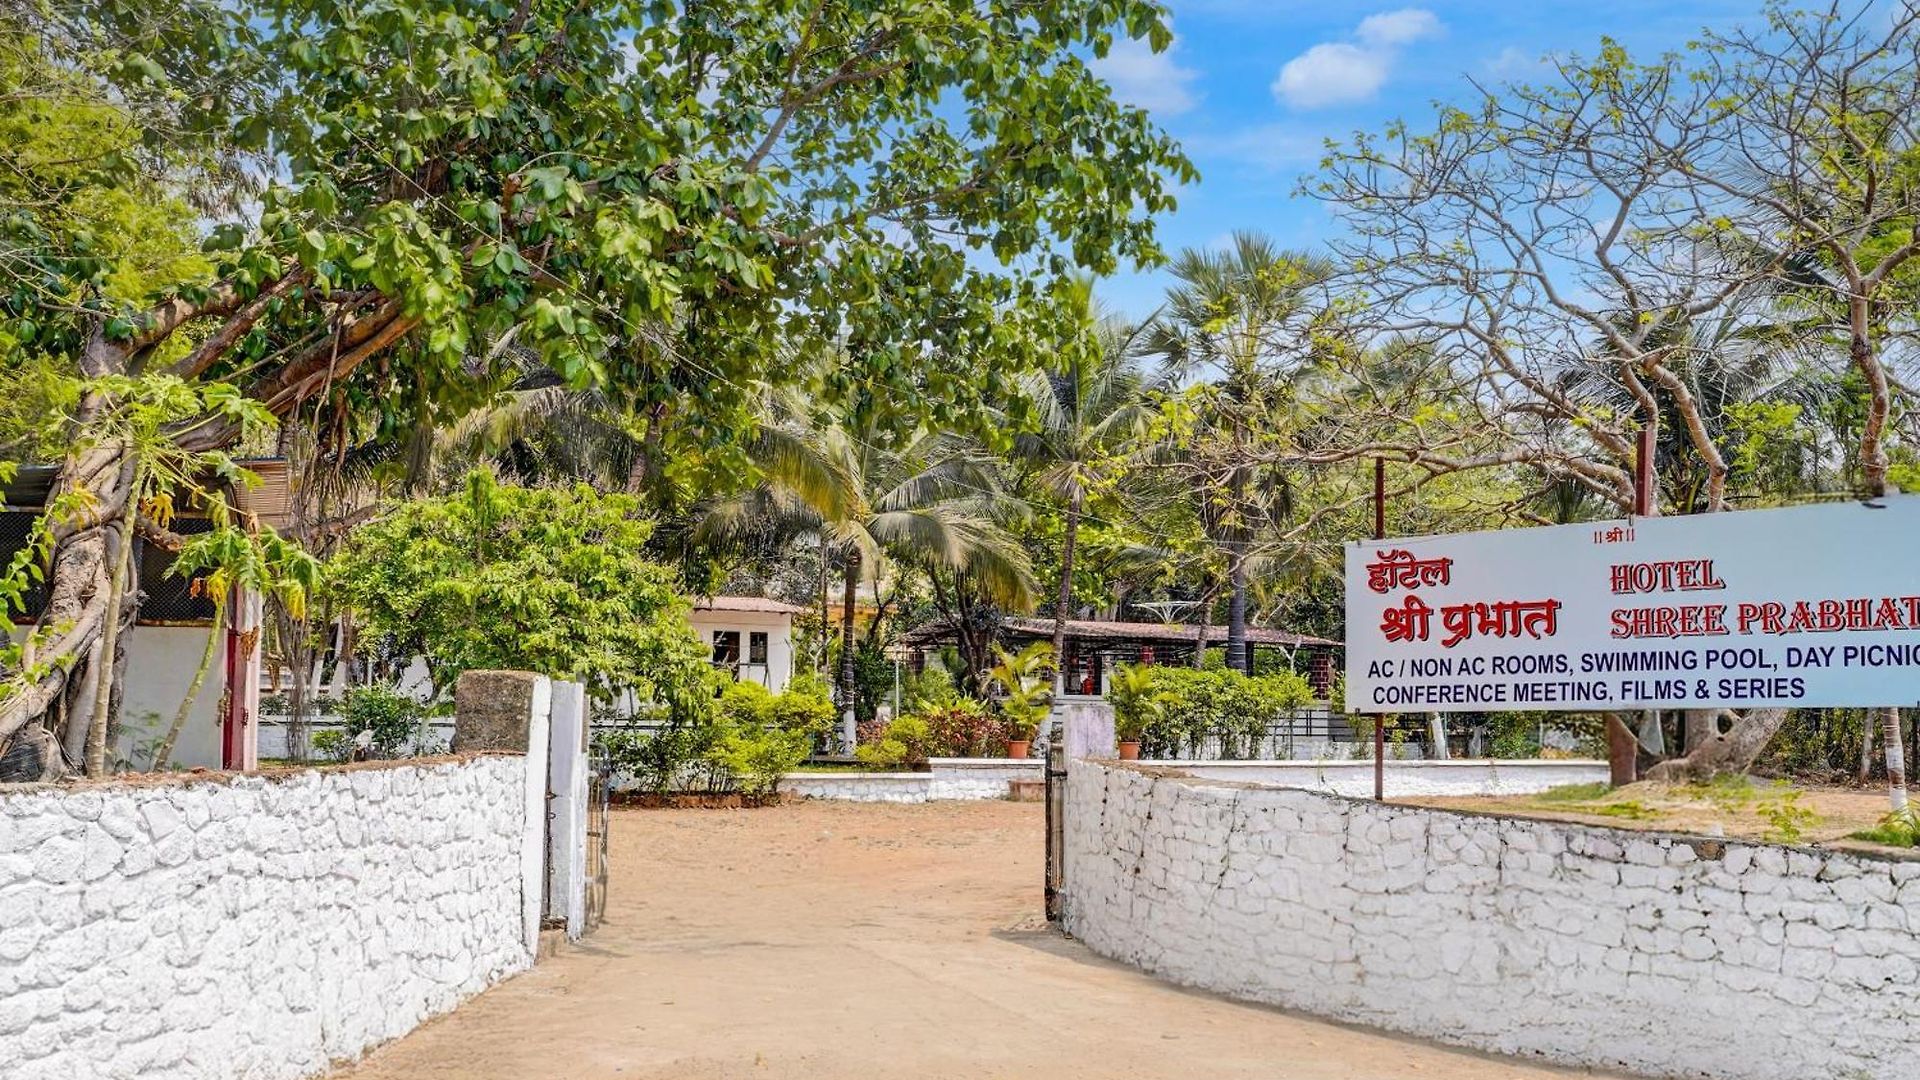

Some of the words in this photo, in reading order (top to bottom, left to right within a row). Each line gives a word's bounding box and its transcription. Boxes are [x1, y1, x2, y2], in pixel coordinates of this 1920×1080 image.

[1366, 549, 1453, 594] हॉटेल
[1609, 559, 1726, 595] HOTEL
[1380, 594, 1434, 642] श्री
[1441, 598, 1562, 648] प्रभात
[1610, 604, 1730, 639] SHREE
[1737, 595, 1920, 636] PRABHAT
[1368, 659, 1394, 678] AC
[1411, 658, 1452, 678] NON
[1457, 656, 1485, 676] AC
[1492, 654, 1574, 677] ROOMS,
[1581, 650, 1698, 673] SWIMMING
[1705, 648, 1778, 673] POOL,
[1786, 646, 1835, 668] DAY
[1373, 684, 1506, 705] CONFERENCE
[1513, 681, 1613, 704] MEETING,
[1621, 679, 1687, 700] FILMS
[1694, 678, 1710, 700] &
[1718, 677, 1805, 700] SERIES
